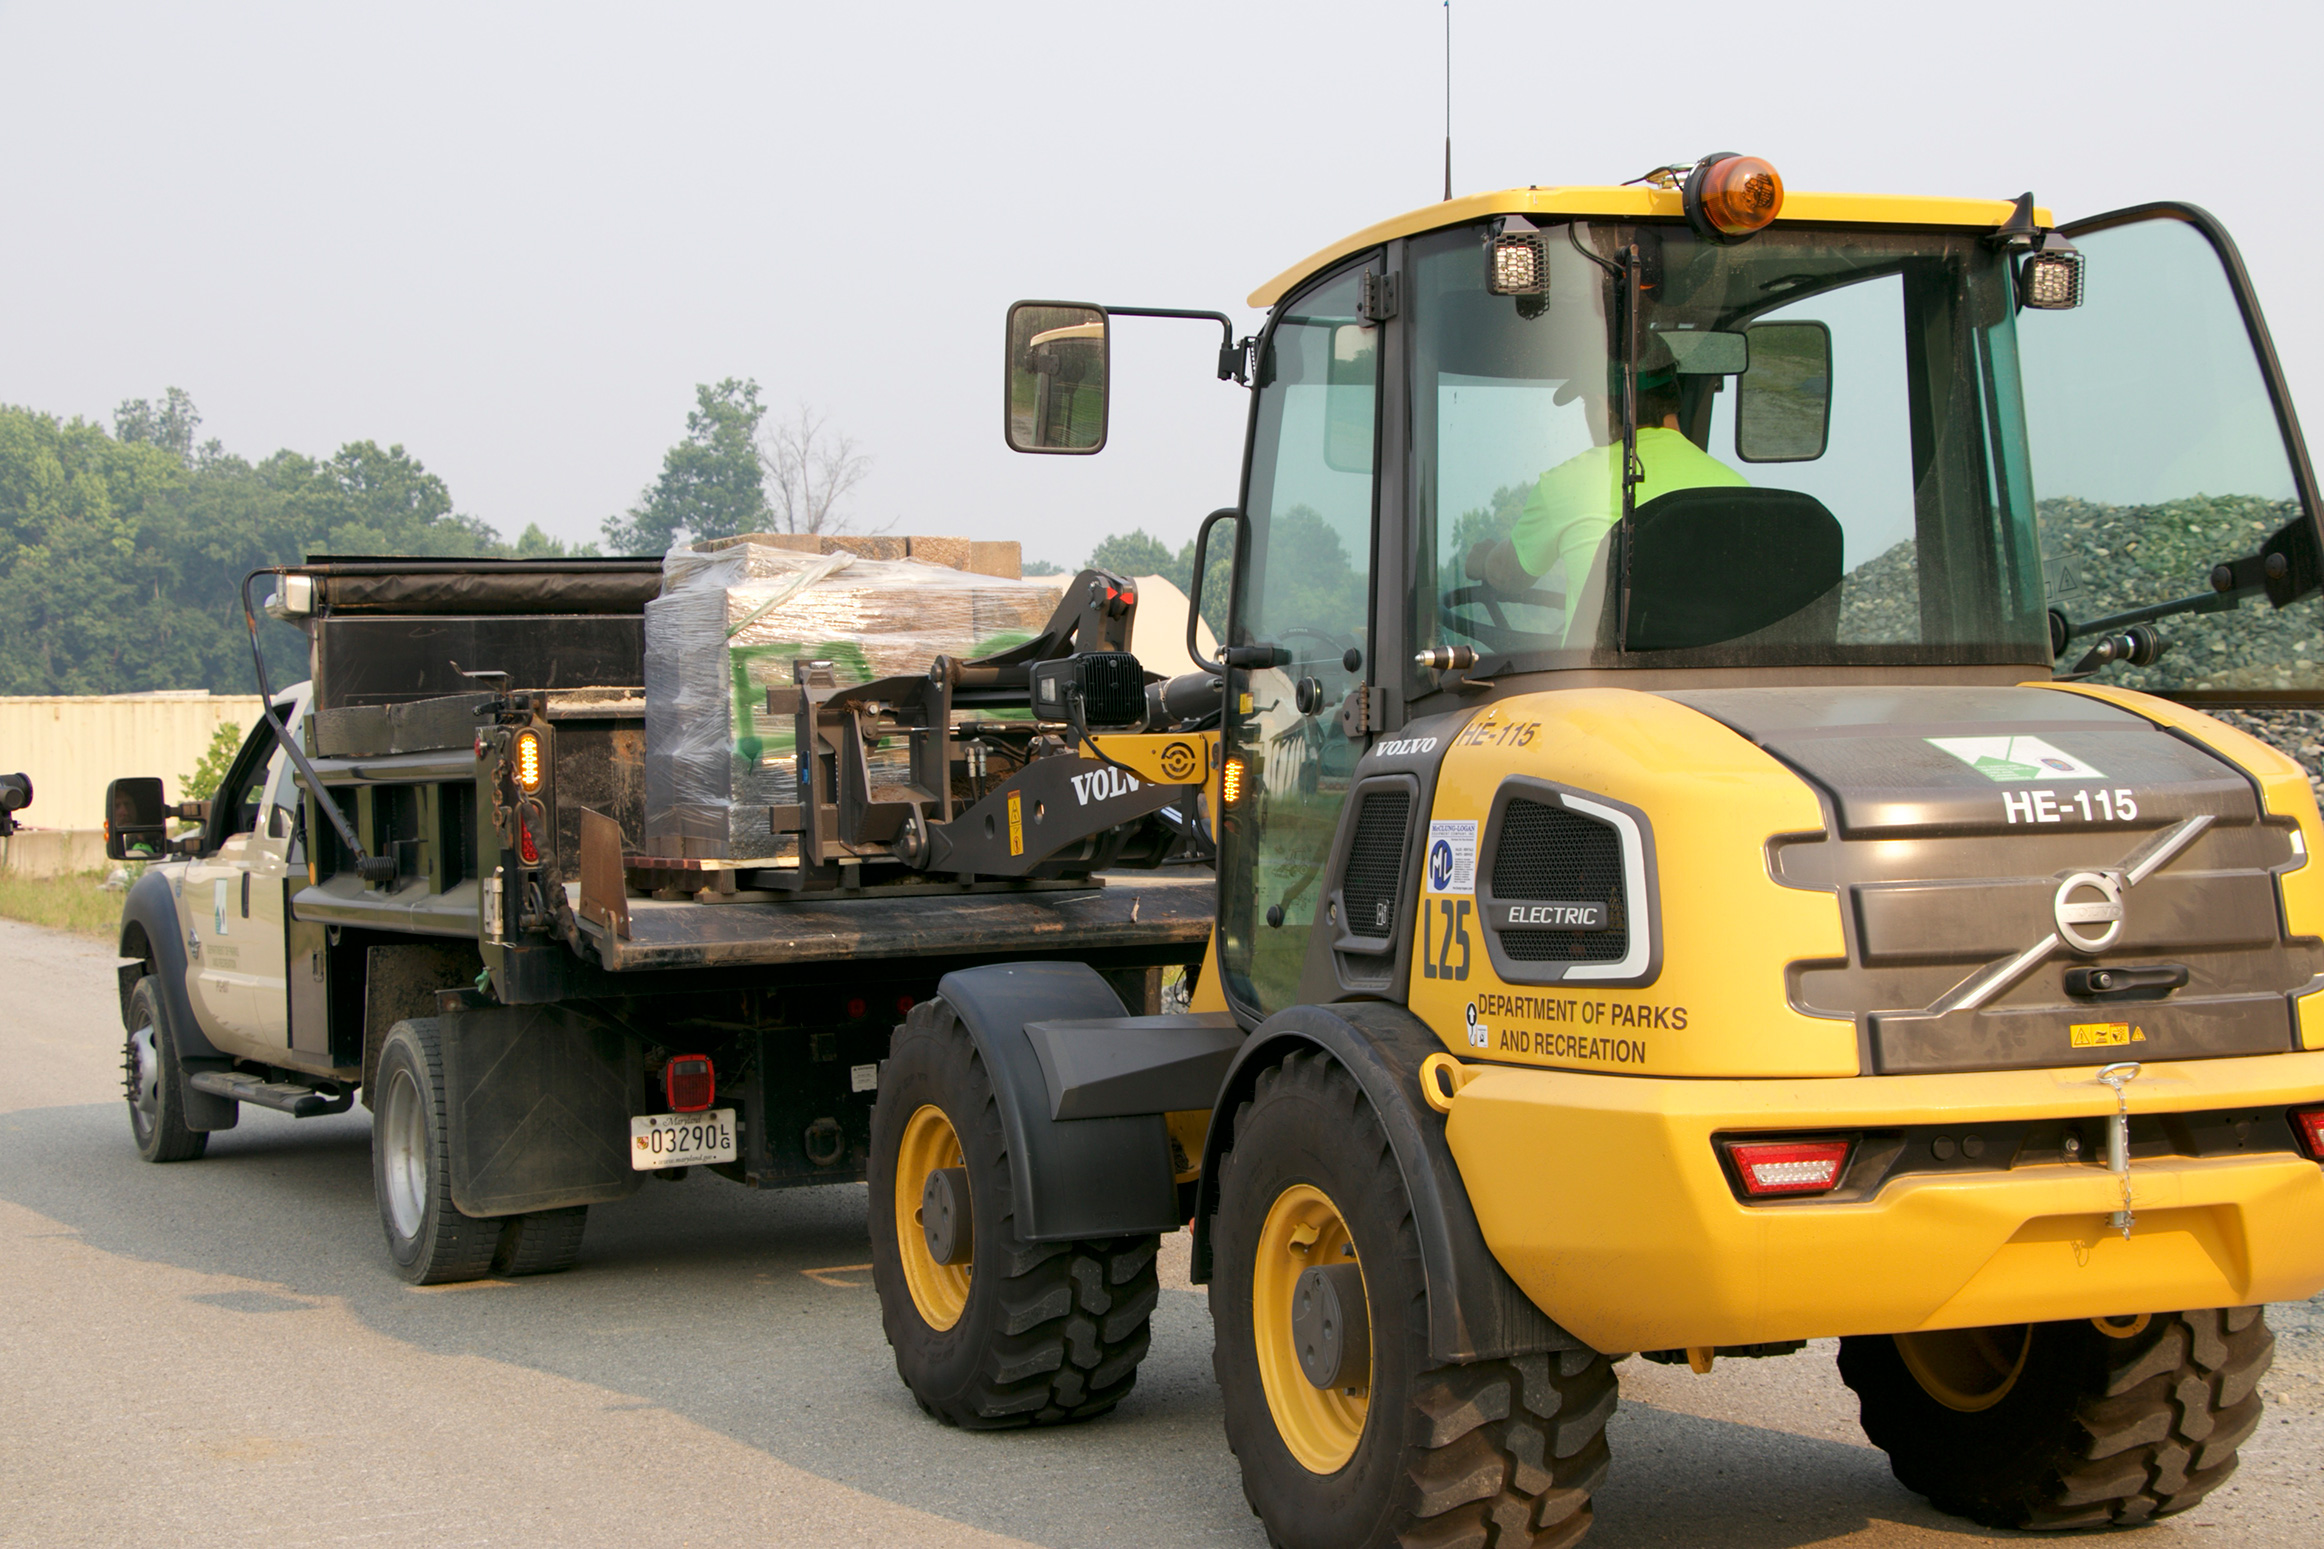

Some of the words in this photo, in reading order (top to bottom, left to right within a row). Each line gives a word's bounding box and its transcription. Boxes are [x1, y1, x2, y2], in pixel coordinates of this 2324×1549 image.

[1375, 736, 1438, 758] VOLVO
[1455, 722, 1541, 747] HE-115
[1070, 765, 1156, 806] VOLV
[2002, 788, 2139, 824] HE-115
[1508, 905, 1598, 926] ELECTRIC
[1423, 898, 1471, 982] L25
[1478, 993, 1577, 1022] DEPARTMENT
[1581, 1001, 1606, 1024] OF
[1610, 1003, 1689, 1031] PARKS
[1499, 1030, 1530, 1053] AND
[1534, 1033, 1646, 1064] RECREATION
[662, 1115, 702, 1127] Maryland
[651, 1125, 716, 1154] 03290
